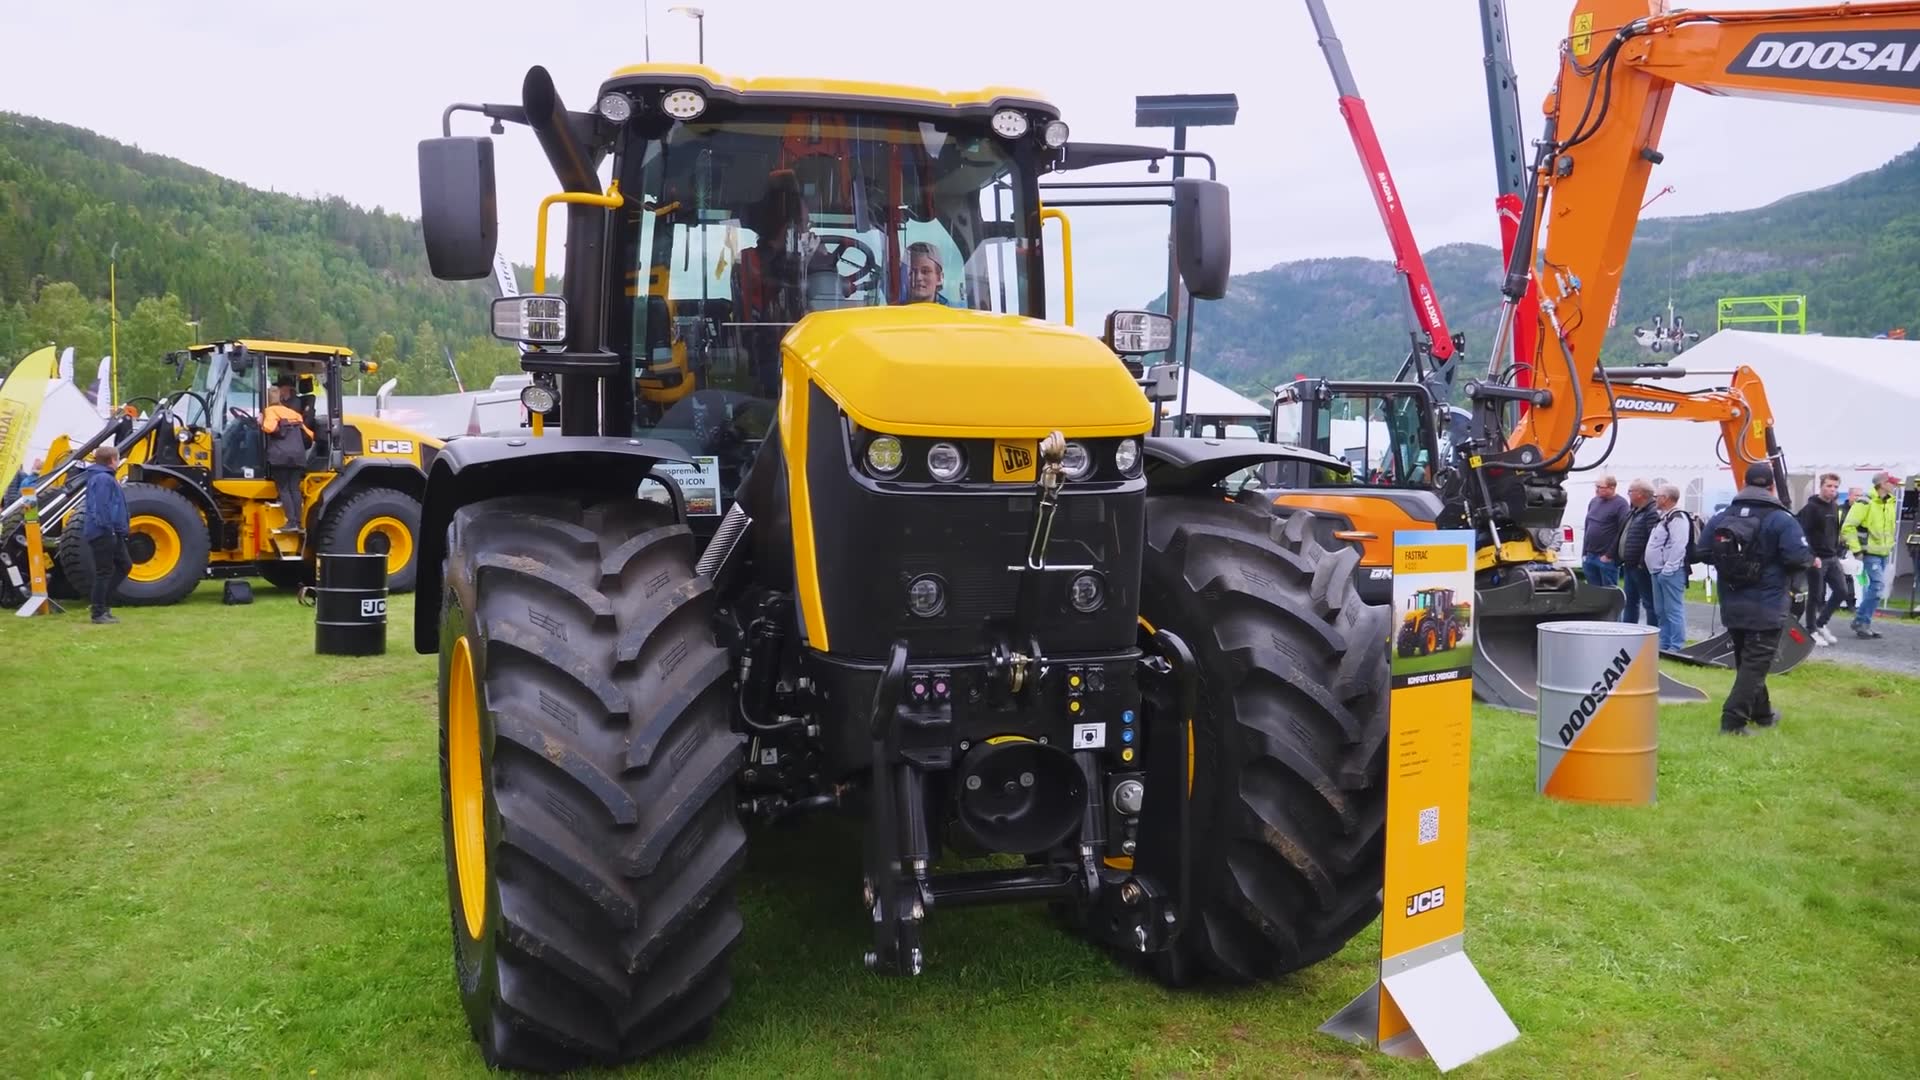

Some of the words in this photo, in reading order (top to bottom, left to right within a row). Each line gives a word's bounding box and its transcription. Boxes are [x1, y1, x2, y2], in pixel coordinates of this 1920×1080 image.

[1615, 399, 1675, 412] DOOSAN
[369, 440, 412, 453] JCB
[1004, 447, 1030, 471] JCB
[686, 478, 705, 486] iCON
[1405, 551, 1428, 560] FASTRAC
[1558, 648, 1631, 747] DOOSAN
[1407, 888, 1444, 916] JCB
